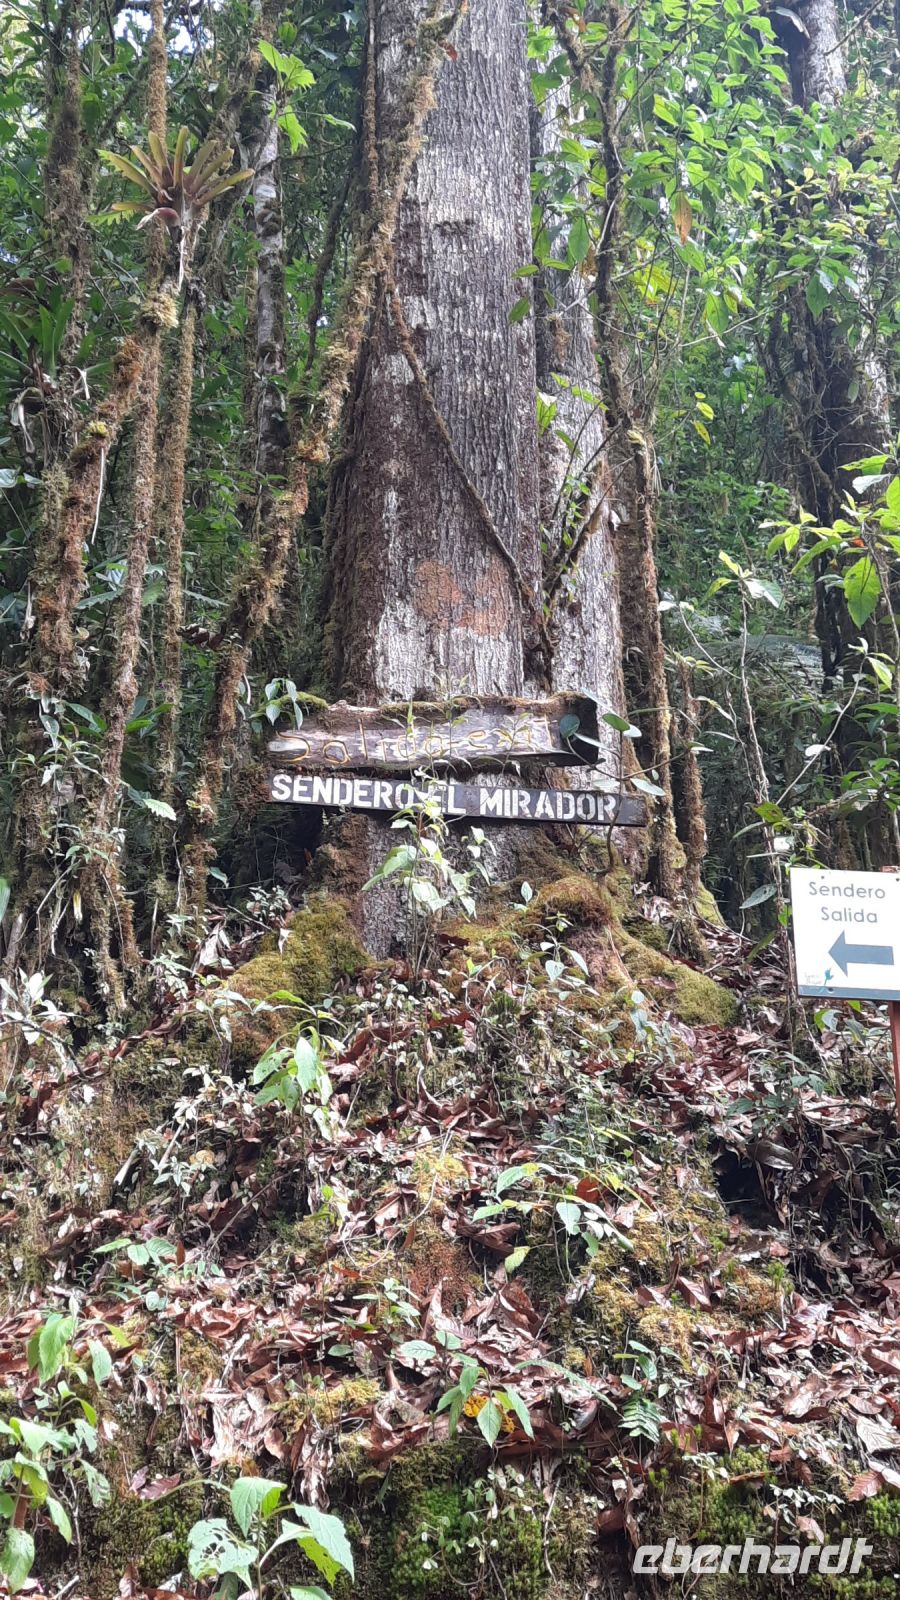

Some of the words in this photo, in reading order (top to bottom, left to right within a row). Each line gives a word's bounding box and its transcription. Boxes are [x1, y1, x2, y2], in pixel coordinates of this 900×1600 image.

[272, 774, 414, 809] SENDERO
[428, 785, 467, 814] EL
[480, 787, 617, 821] MIRADOR
[808, 881, 886, 899] Sendero
[820, 906, 878, 923] Salida
